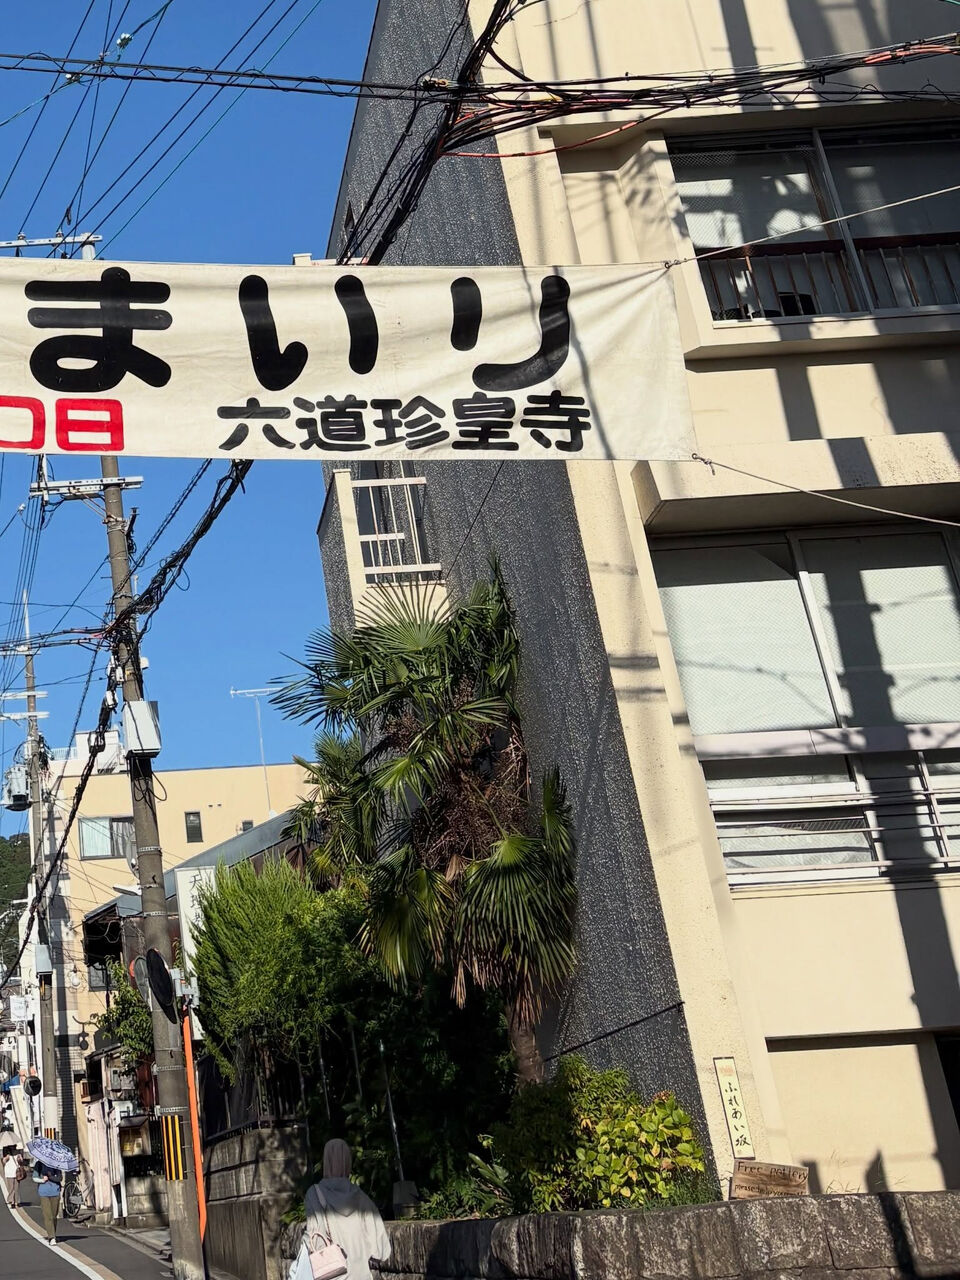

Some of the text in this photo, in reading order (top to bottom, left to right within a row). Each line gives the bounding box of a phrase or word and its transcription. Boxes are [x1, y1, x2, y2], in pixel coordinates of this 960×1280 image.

[217, 390, 591, 452] 六道珍皇寺
[738, 1161, 763, 1173] Free
